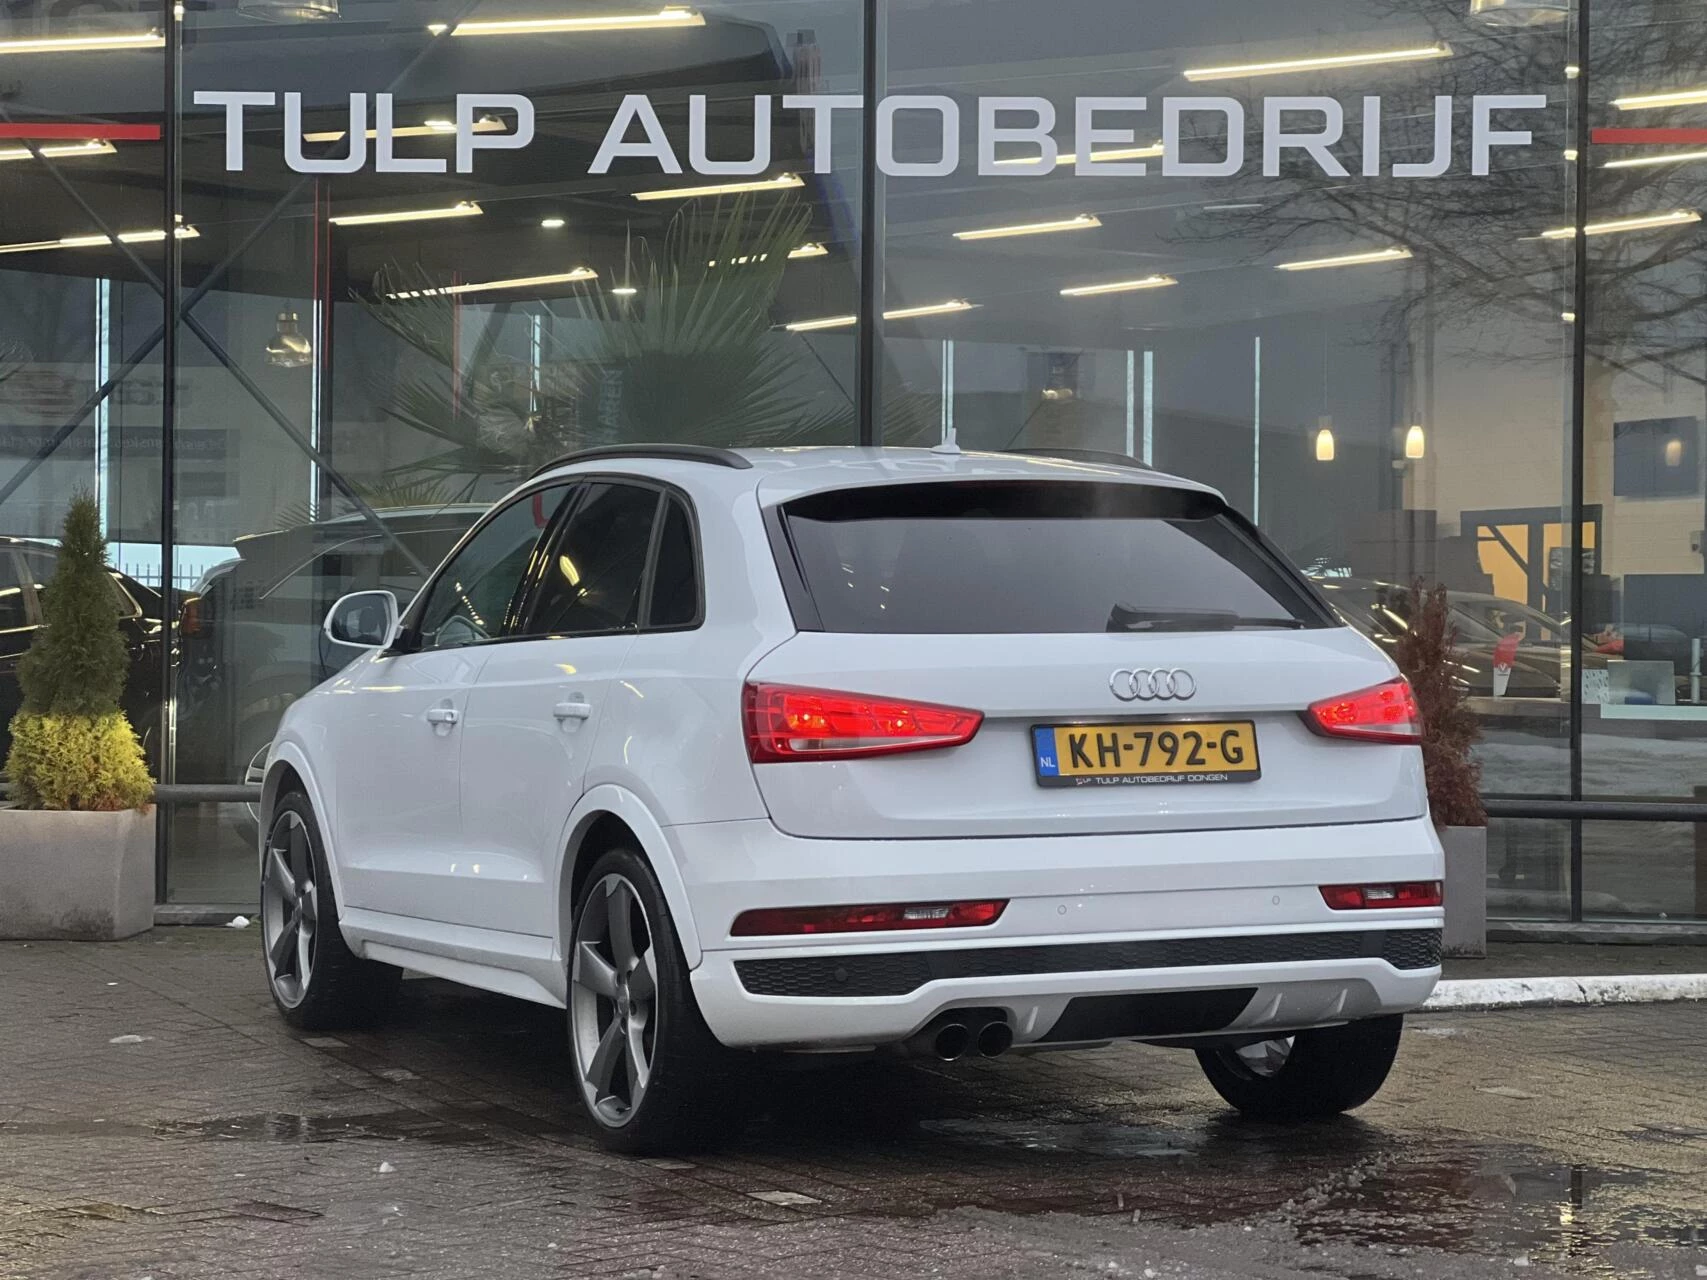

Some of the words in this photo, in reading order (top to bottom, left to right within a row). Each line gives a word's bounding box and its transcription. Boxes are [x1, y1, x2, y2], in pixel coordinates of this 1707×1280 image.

[193, 91, 534, 174] TULP
[587, 94, 1547, 178] AUTOBEDRIJF
[1068, 730, 1244, 768] KH-792-G
[1040, 756, 1056, 768] NL
[1095, 776, 1120, 785] TULP
[1122, 774, 1185, 784] AUTOBEDRIJF
[1187, 773, 1228, 782] DONGEN
